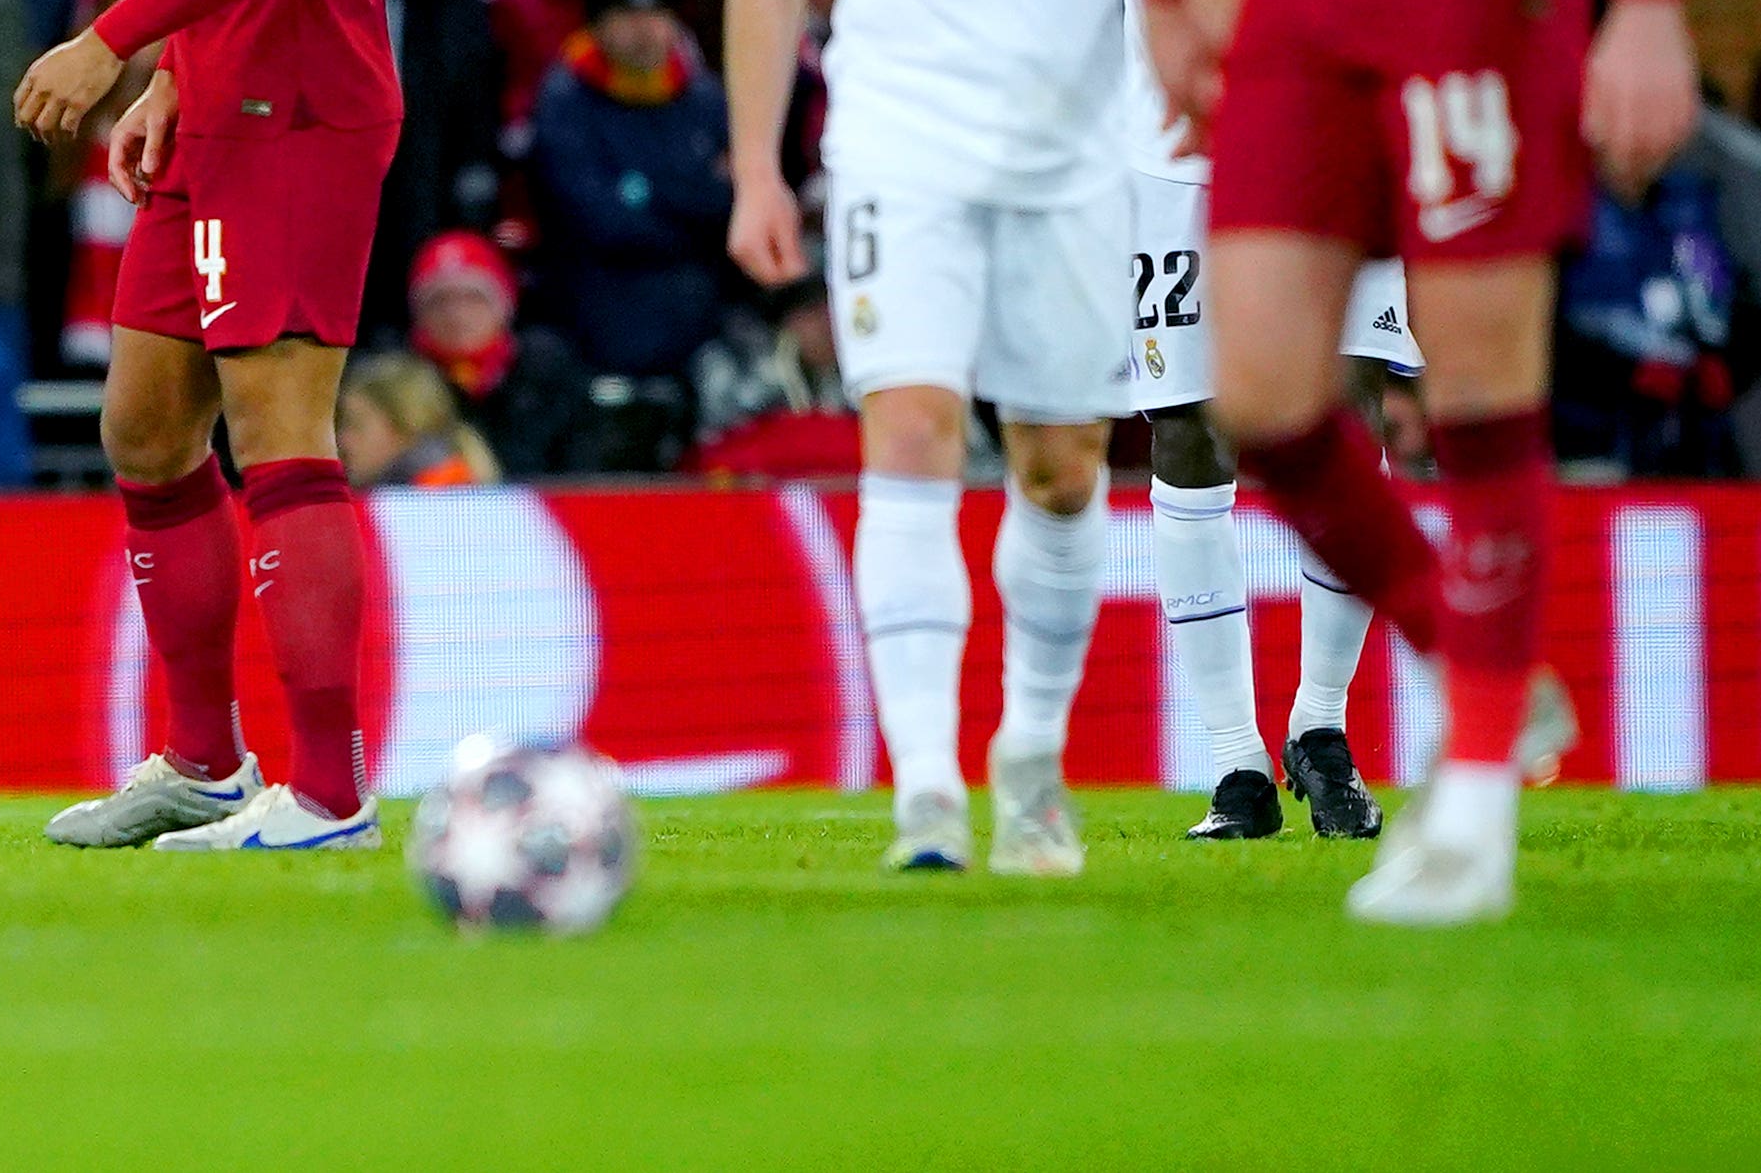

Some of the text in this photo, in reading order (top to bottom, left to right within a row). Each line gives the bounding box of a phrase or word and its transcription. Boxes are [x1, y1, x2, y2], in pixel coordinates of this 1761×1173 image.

[1401, 69, 1520, 204] 14
[194, 218, 227, 302] 4
[845, 201, 878, 282] 6
[1129, 249, 1202, 331] 22
[1166, 590, 1223, 609] RMCF
